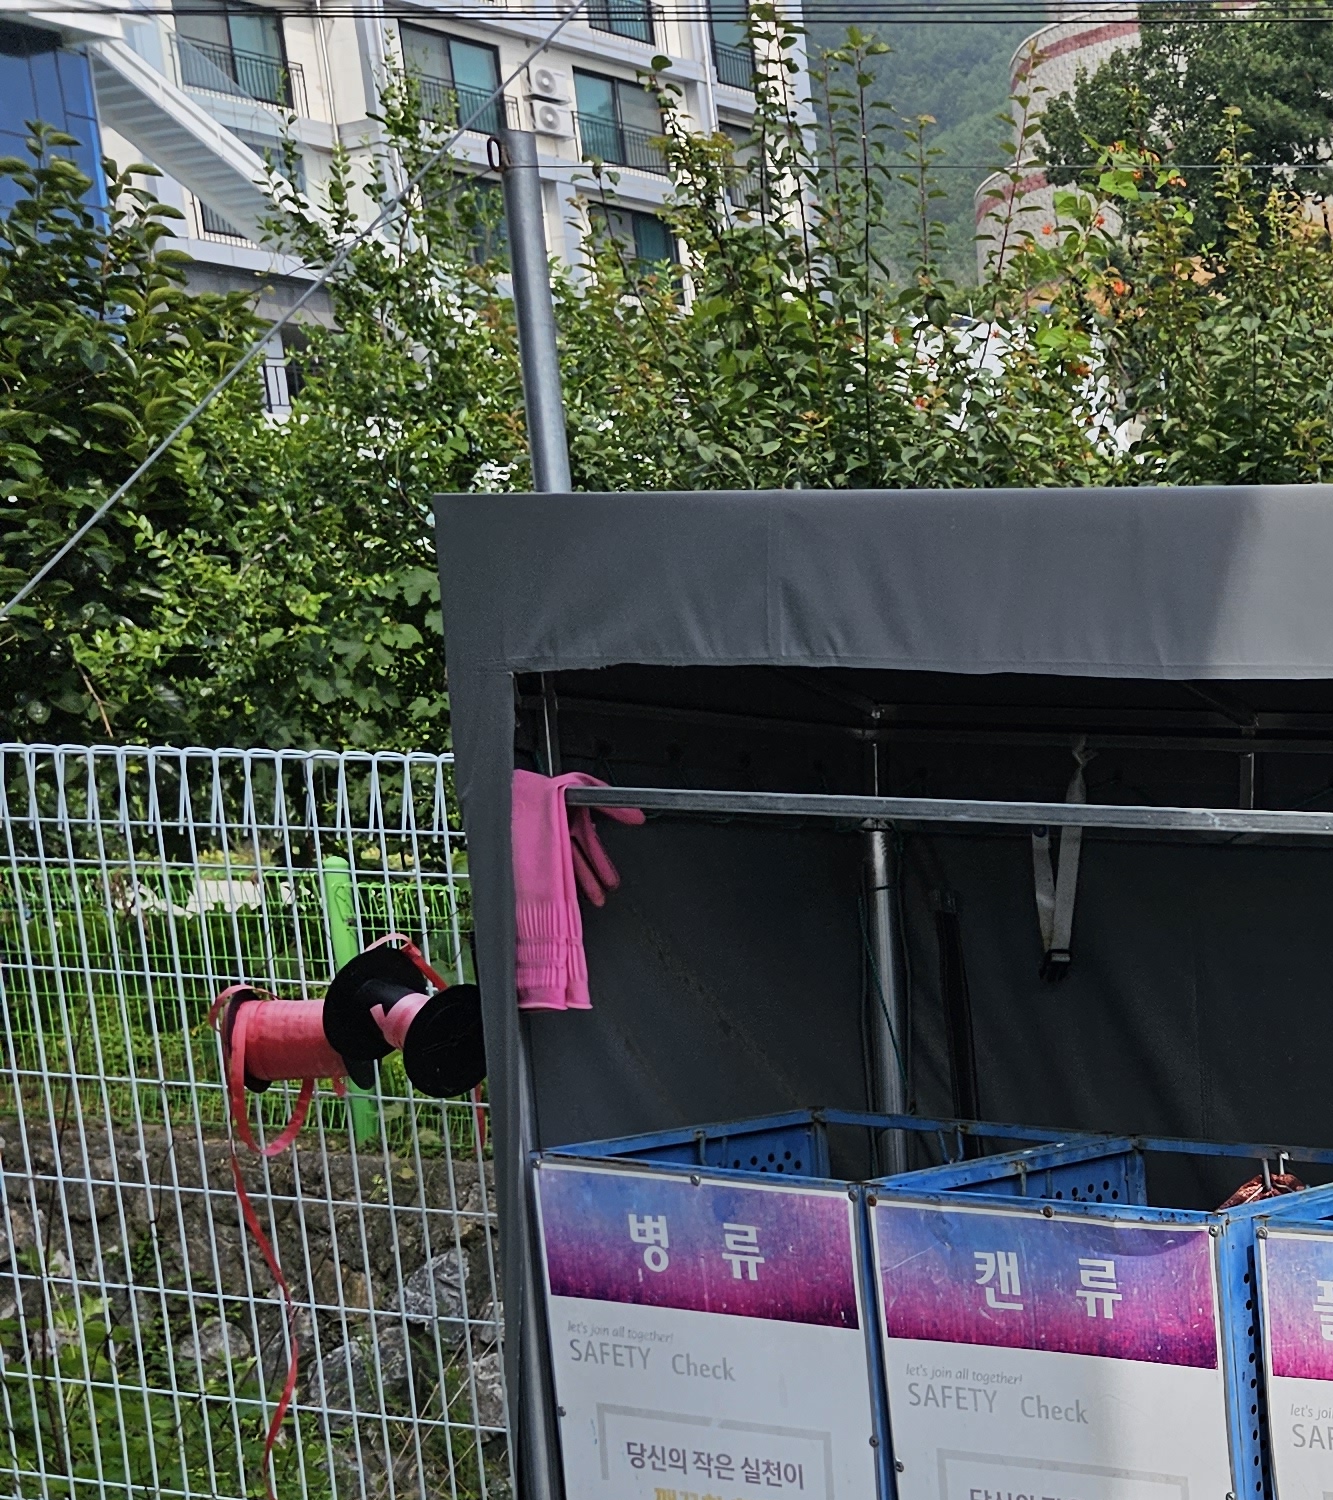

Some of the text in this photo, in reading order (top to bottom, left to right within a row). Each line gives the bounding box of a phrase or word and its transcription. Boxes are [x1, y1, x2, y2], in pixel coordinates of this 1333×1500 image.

[569, 1339, 736, 1381] SAFETY Check
[906, 1364, 1022, 1385] let's join all together!
[908, 1382, 1089, 1424] SAFETY Check
[1290, 1404, 1313, 1417] let's
[627, 1441, 804, 1490] 당신의 작은 실천이
